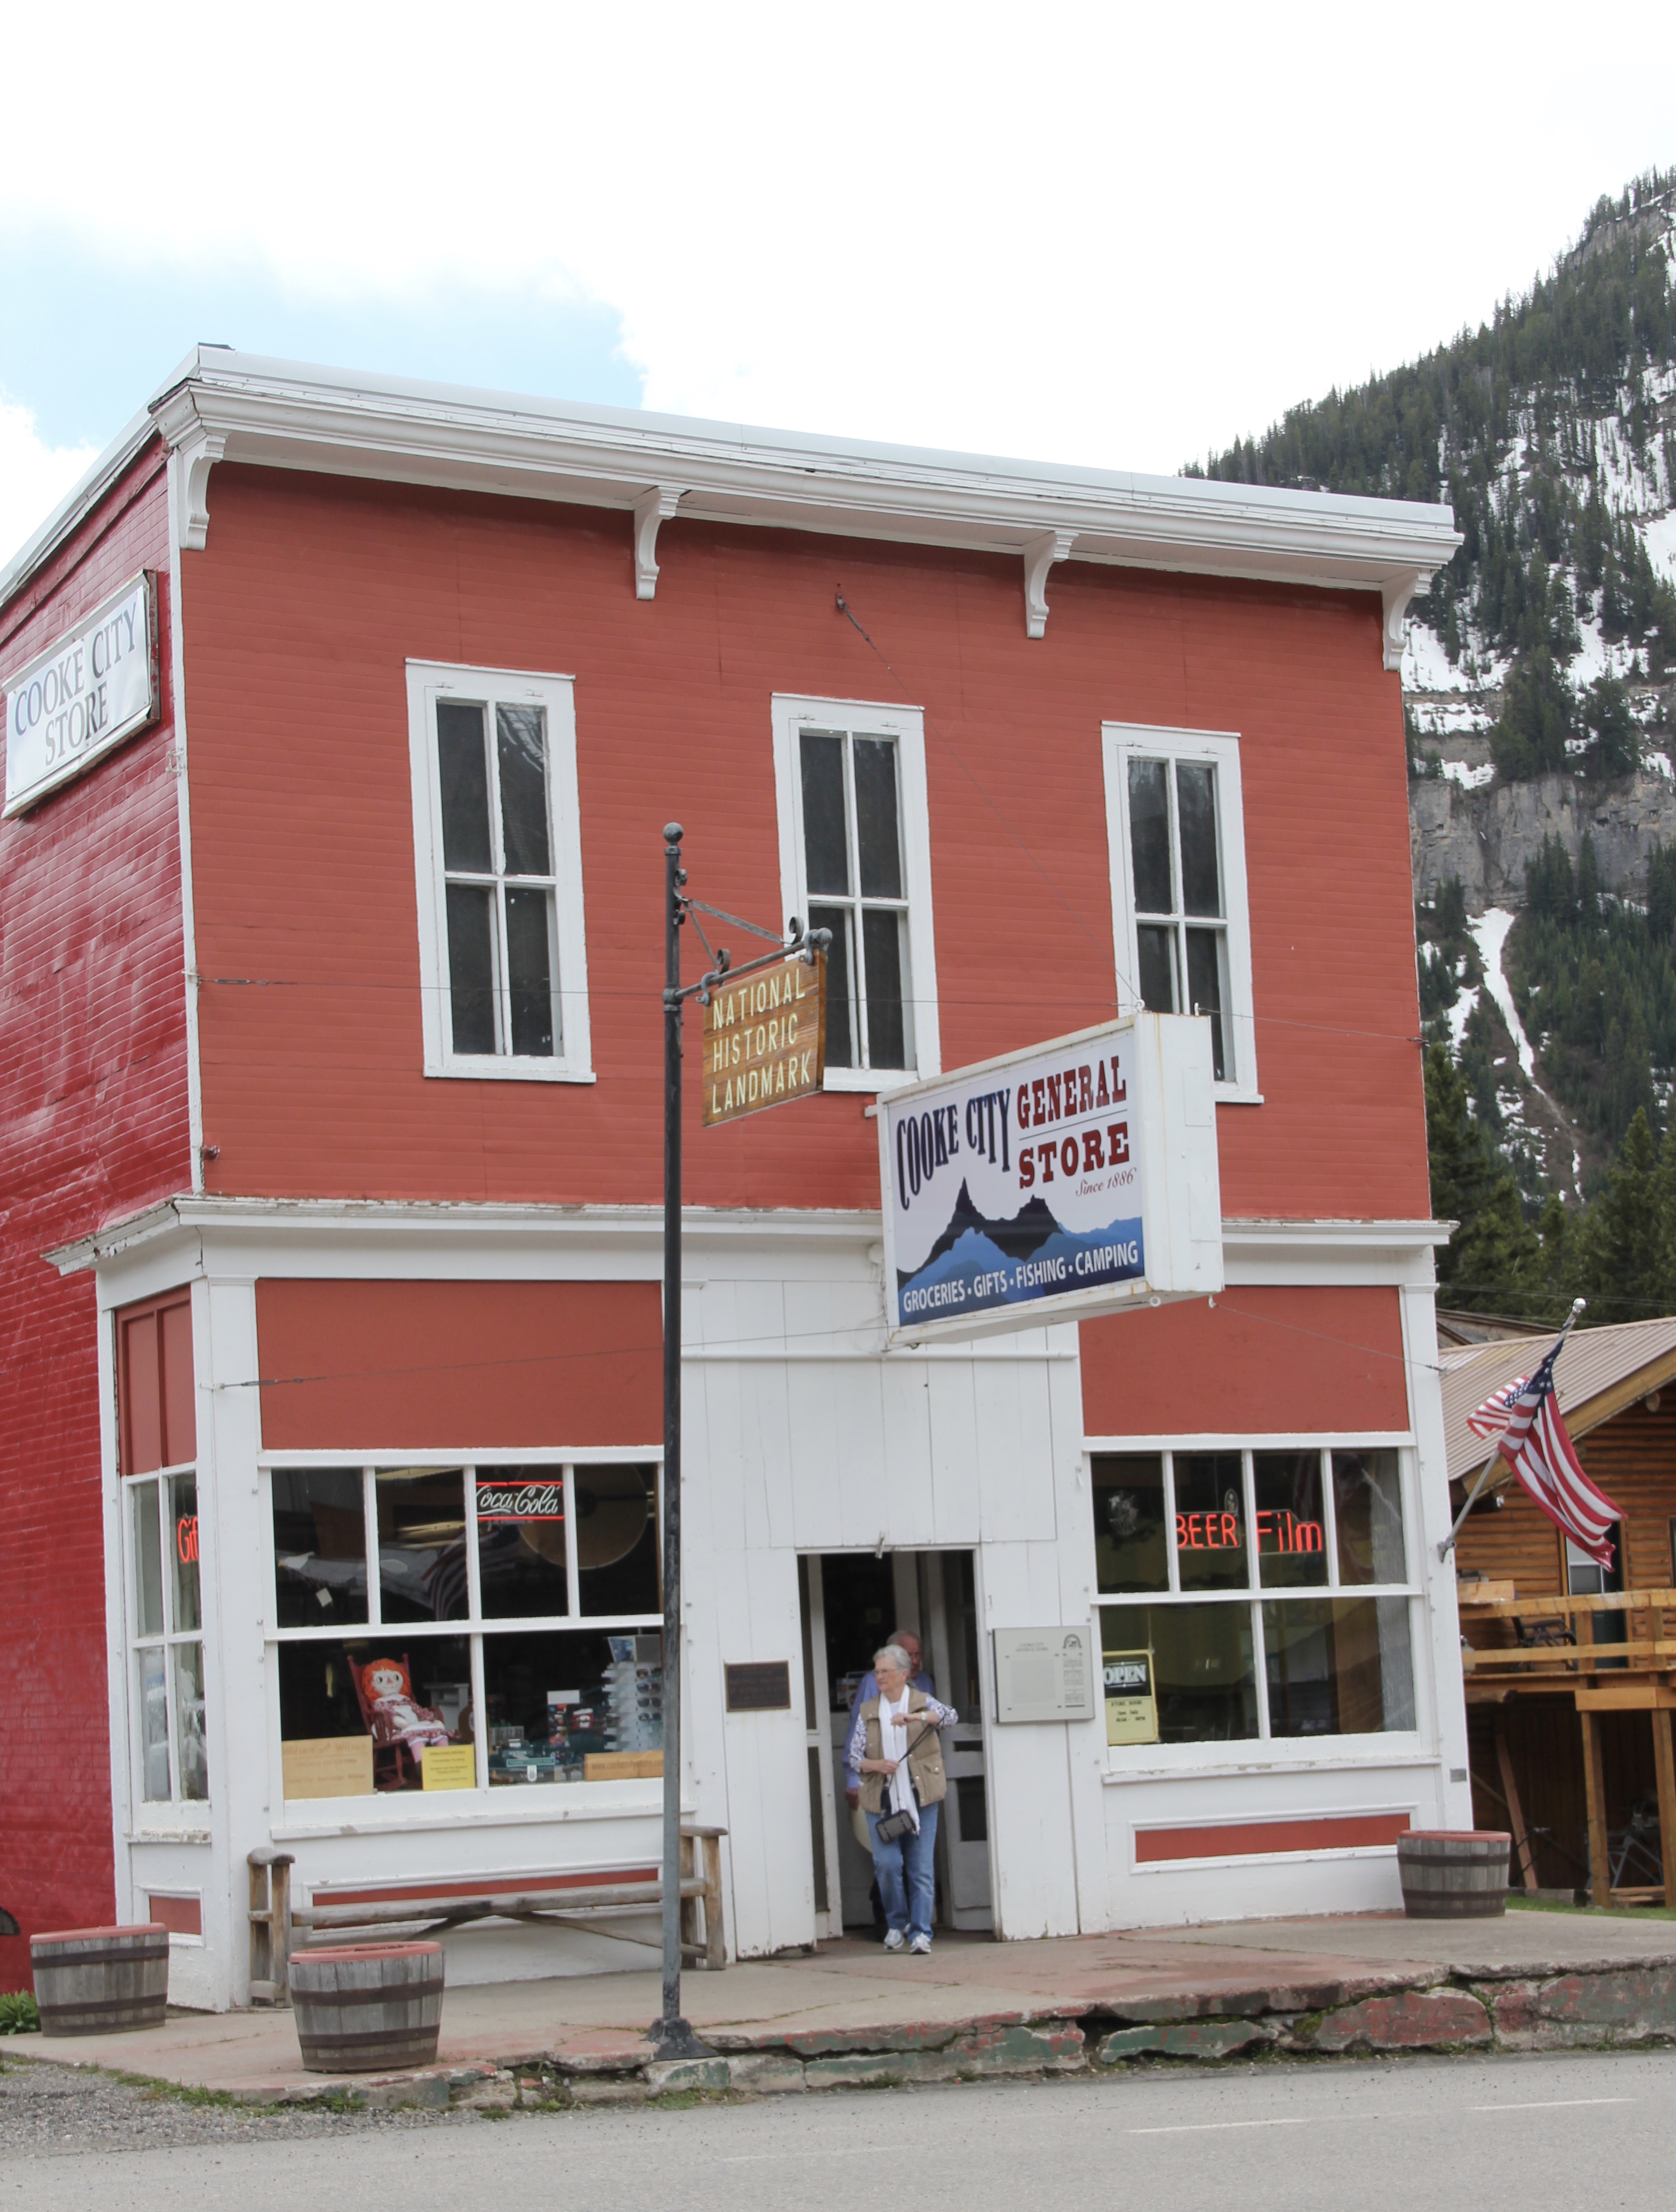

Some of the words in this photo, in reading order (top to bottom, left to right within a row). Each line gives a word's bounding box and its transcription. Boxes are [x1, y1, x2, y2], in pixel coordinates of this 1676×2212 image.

[15, 647, 85, 736] COOKE
[92, 602, 137, 679] CITY
[45, 680, 109, 766] STORE
[713, 968, 806, 1030] NATIONAL
[713, 1012, 798, 1073] HISTORIC
[712, 1050, 811, 1114] LANDMARK
[1017, 1055, 1127, 1130] GENERAL
[896, 1103, 959, 1210] COOKE
[965, 1088, 1011, 1173] CITY
[1018, 1121, 1130, 1189] STORE
[1076, 1179, 1104, 1197] Since
[1107, 1167, 1137, 1189] 1886
[903, 1280, 966, 1313] GROCERIES
[973, 1271, 1008, 1298] GIFTS
[1016, 1257, 1066, 1288] FISHING
[1075, 1240, 1138, 1275] CAMPING
[177, 1517, 198, 1563] Gif
[1176, 1513, 1238, 1549] BEER
[1257, 1511, 1322, 1553] Film
[1103, 1664, 1146, 1685] OPEN
